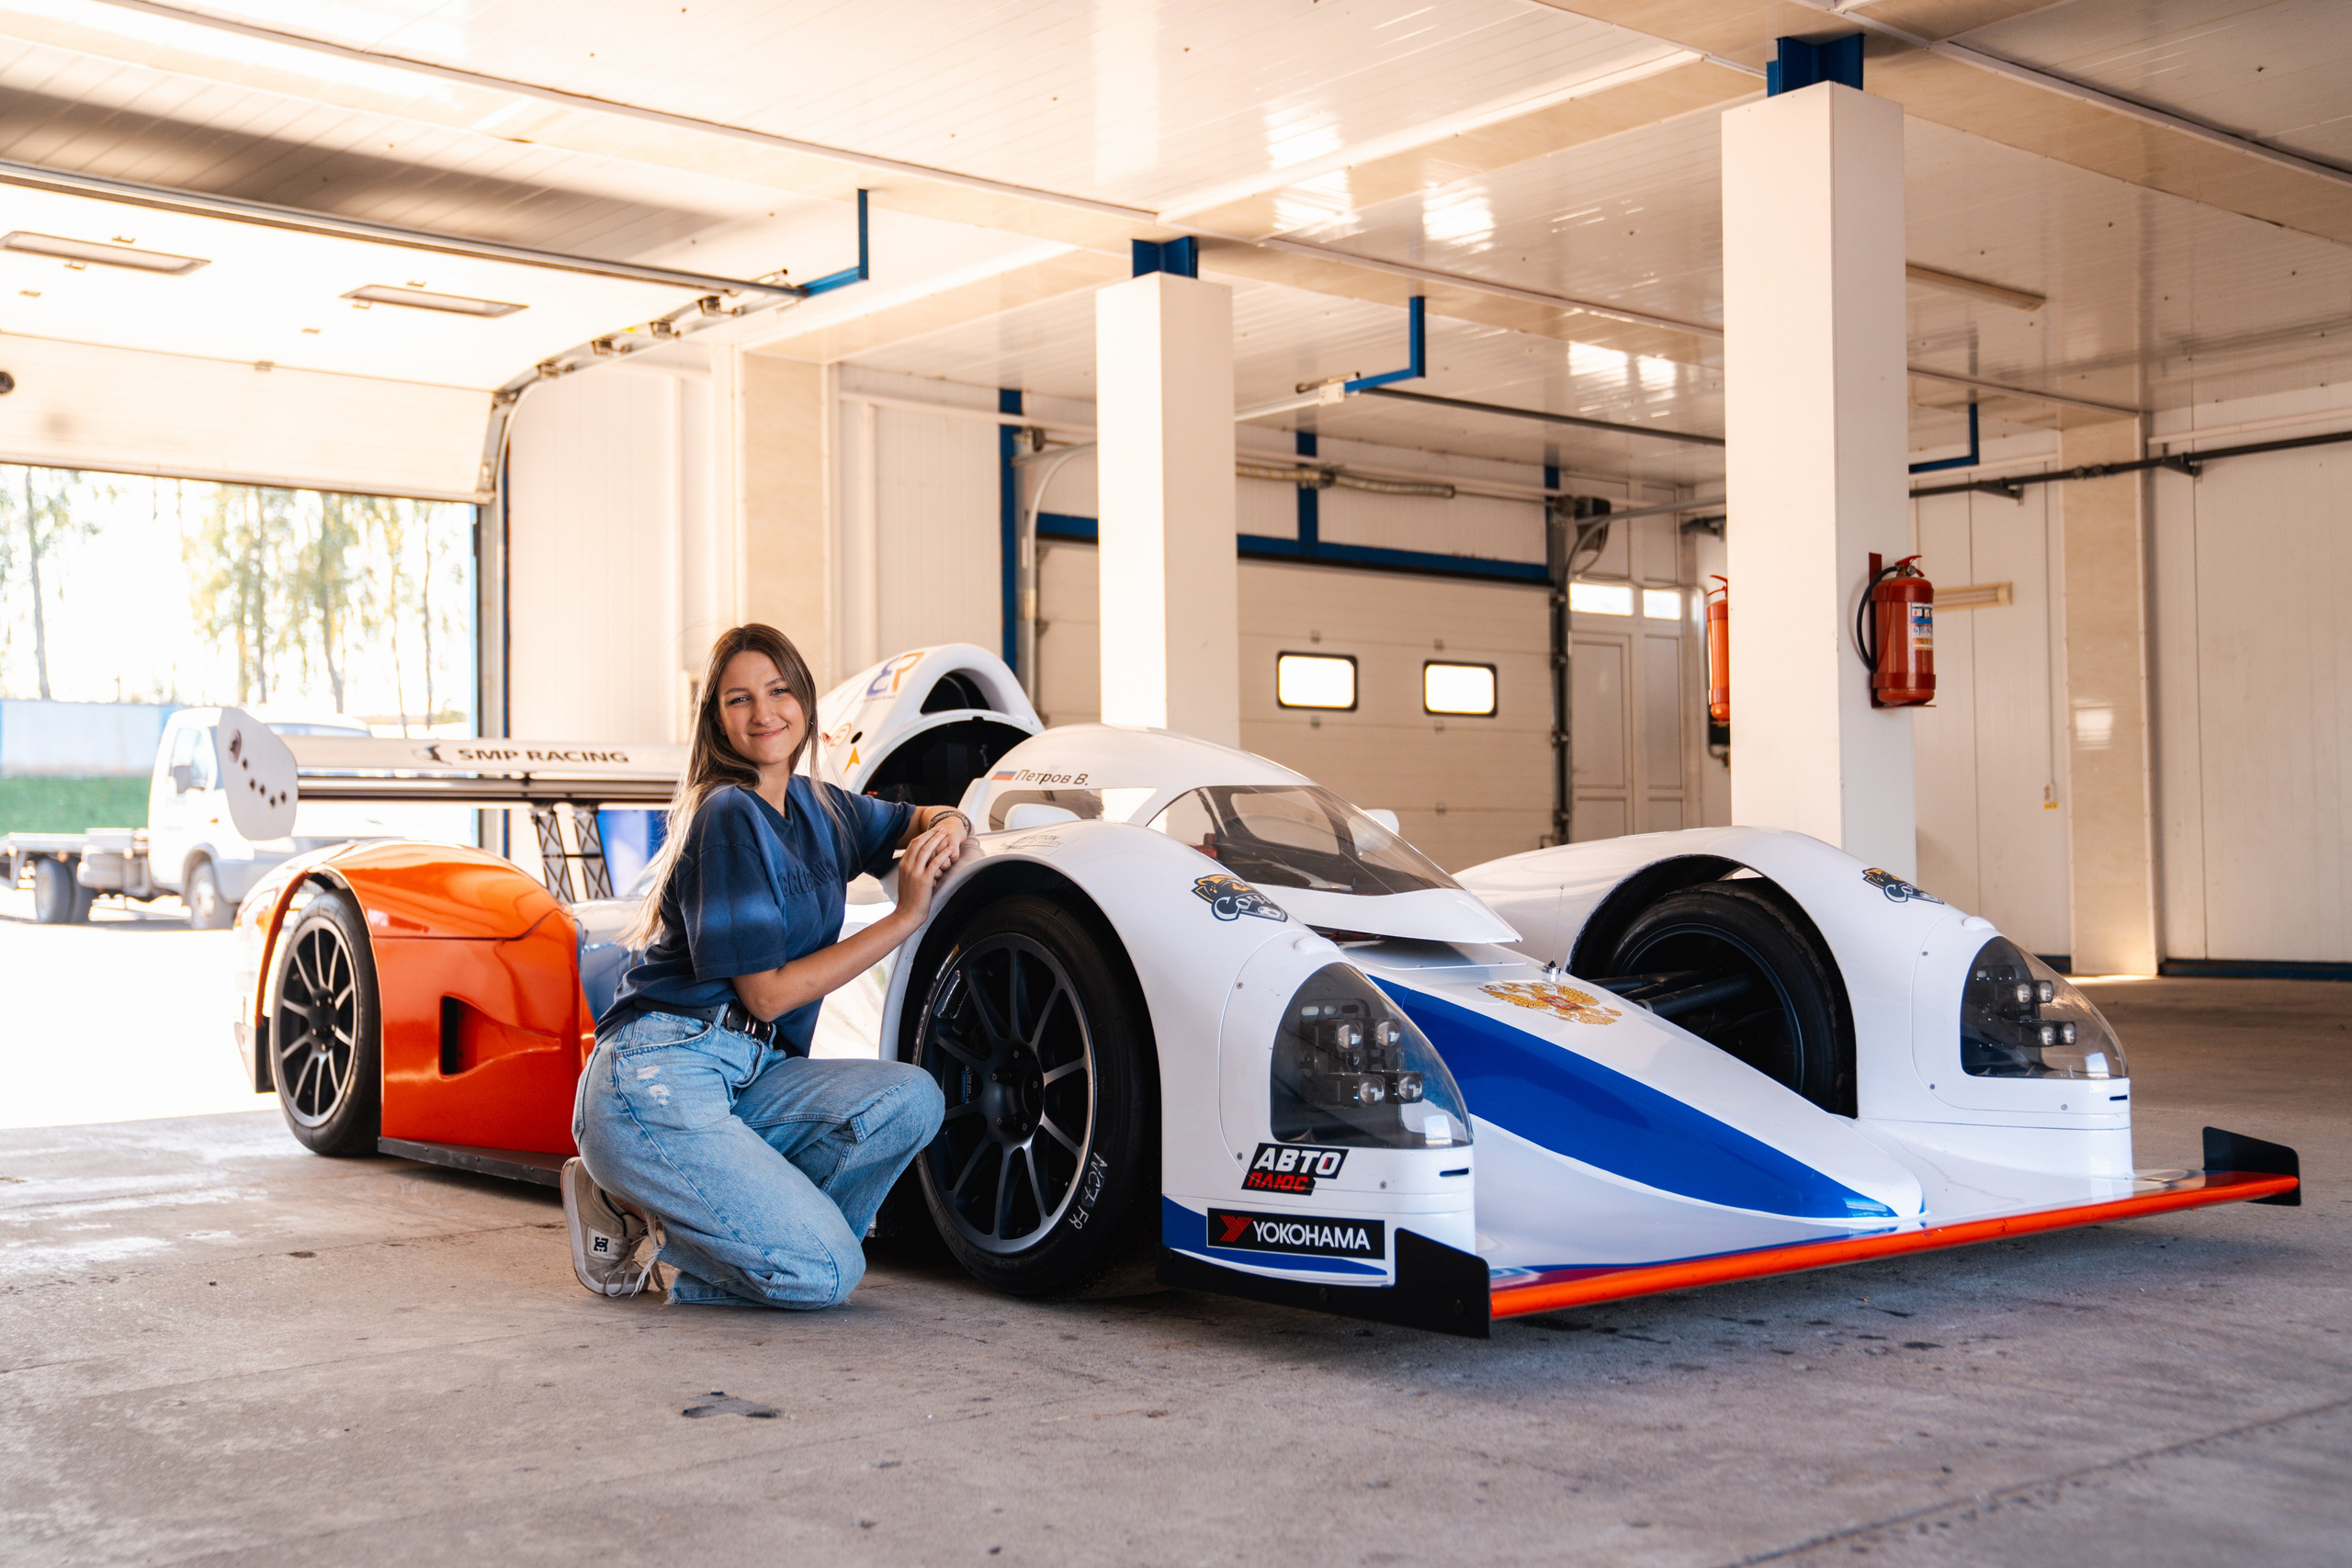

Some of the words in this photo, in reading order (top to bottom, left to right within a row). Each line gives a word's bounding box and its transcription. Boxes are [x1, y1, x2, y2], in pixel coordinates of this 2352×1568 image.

[458, 748, 518, 761] SMP
[525, 749, 629, 763] RACING
[1014, 769, 1071, 784] Петров
[1073, 773, 1089, 785] В.
[1253, 1147, 1342, 1176] АВТО
[1247, 1172, 1309, 1191] ПЛЮС
[1252, 1220, 1371, 1250] YOKOHAMA
